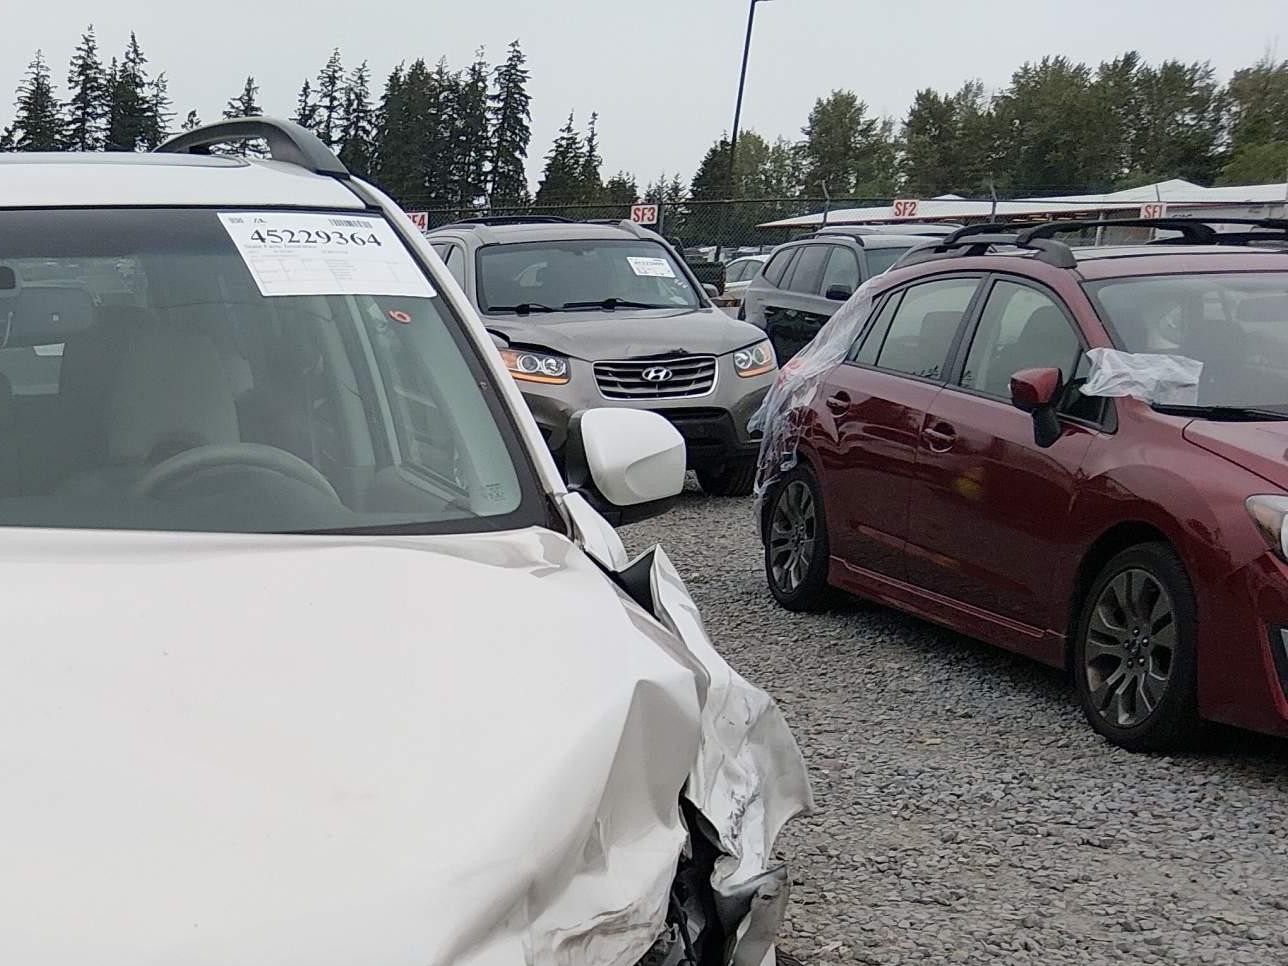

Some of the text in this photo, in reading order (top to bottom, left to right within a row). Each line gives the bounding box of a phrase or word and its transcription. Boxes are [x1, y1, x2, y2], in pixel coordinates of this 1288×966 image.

[633, 206, 656, 223] SF3
[894, 201, 917, 217] SF2
[250, 228, 382, 247] 45229364
